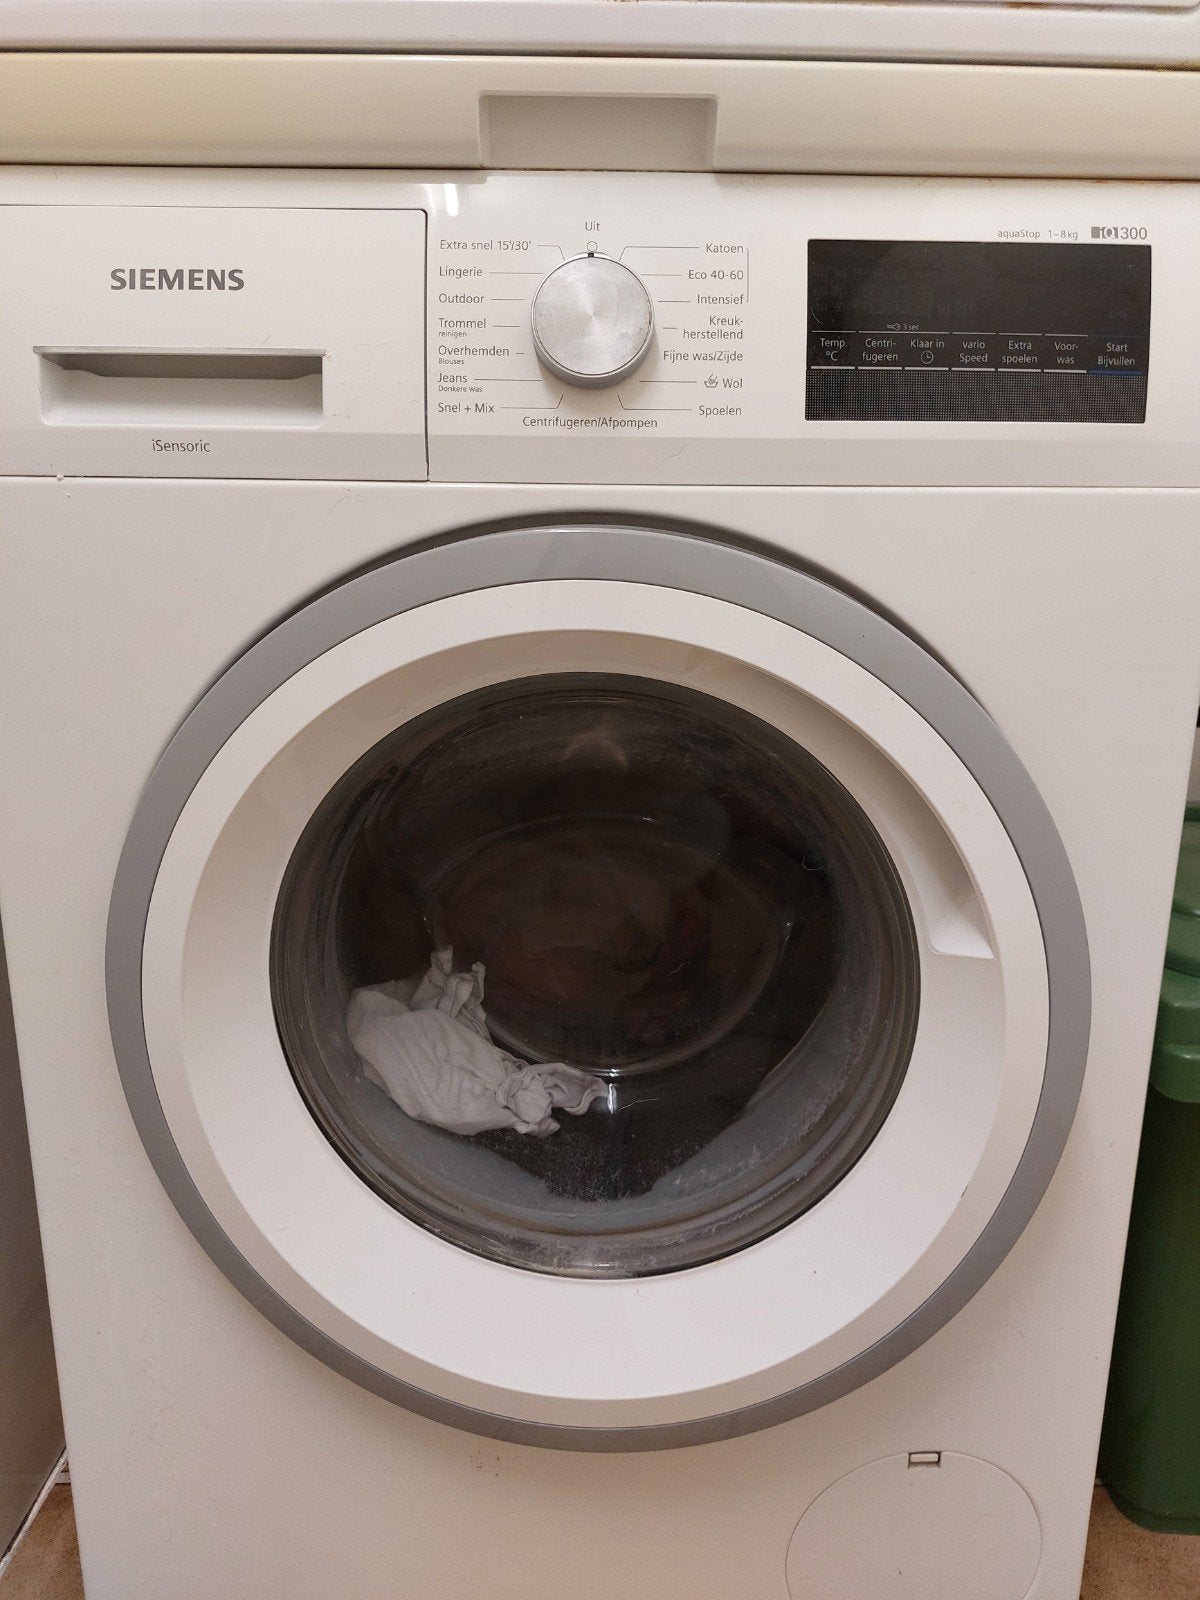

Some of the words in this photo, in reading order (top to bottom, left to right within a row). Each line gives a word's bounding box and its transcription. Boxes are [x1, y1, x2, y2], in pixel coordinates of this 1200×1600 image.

[585, 222, 600, 231] Uit
[997, 229, 1041, 240] aquaStop
[440, 240, 468, 250] Extra
[471, 240, 493, 250] snel
[705, 243, 744, 253] Katoen
[439, 266, 483, 278] Lingerie
[688, 270, 707, 280] Eco
[710, 270, 744, 280] 40-60
[110, 268, 245, 291] SIEMENS
[438, 293, 485, 304] Outdoor
[696, 294, 744, 305] Intensief
[438, 318, 487, 328] Trommel
[709, 315, 744, 326] Kreuk-
[438, 330, 467, 338] reinigen
[683, 328, 744, 340] herstellend
[820, 338, 848, 350] Temp.
[865, 338, 897, 348] Centri-
[910, 339, 933, 349] Klaar
[936, 339, 945, 349] in
[962, 340, 985, 349] vario
[1008, 341, 1032, 350] Extra
[1054, 342, 1079, 351] Voor-
[1106, 342, 1128, 352] Start
[438, 345, 510, 356] Overhemden
[438, 357, 465, 365] Blouses
[663, 350, 690, 364] Fijne
[692, 350, 744, 362] was/Zijde
[862, 353, 899, 364] fugeren
[959, 353, 988, 364] Speed
[1002, 354, 1038, 365] spoelen
[1056, 357, 1075, 365] was
[1097, 356, 1135, 368] Bijvullen
[437, 373, 468, 383] Jeans
[722, 378, 743, 389] Wol
[438, 385, 467, 393] Donkere
[437, 403, 461, 413] Snel
[474, 403, 495, 414] Mix
[699, 405, 742, 417] Spoelen
[522, 416, 659, 431] Centrifugeren/Afpompen
[152, 438, 211, 453] iSensoric
